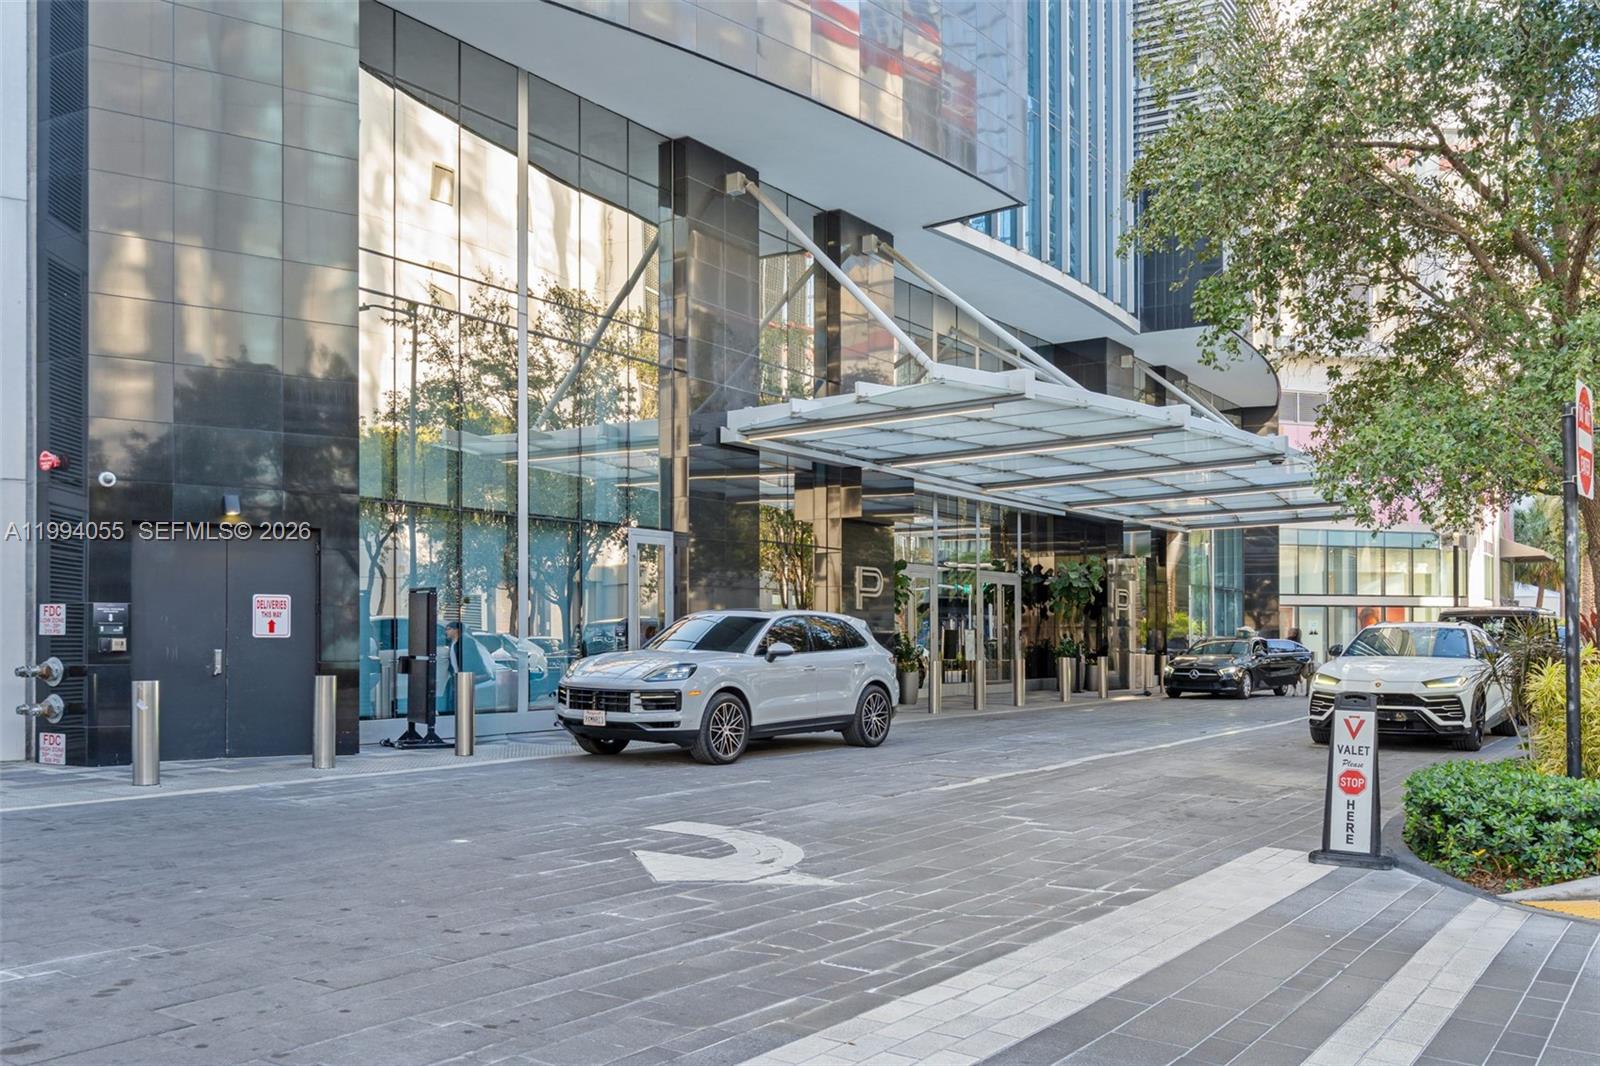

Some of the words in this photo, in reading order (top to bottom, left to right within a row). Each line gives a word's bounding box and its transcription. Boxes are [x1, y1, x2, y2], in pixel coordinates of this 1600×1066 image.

[854, 566, 884, 610] P
[256, 599, 287, 610] DELIVERIES
[43, 605, 61, 617] FDC
[1343, 718, 1366, 740] V
[43, 734, 61, 745] FDC
[1337, 744, 1370, 756] VALET
[1342, 759, 1364, 769] Please
[1340, 776, 1365, 788] STOP
[1346, 799, 1355, 845] HERE
